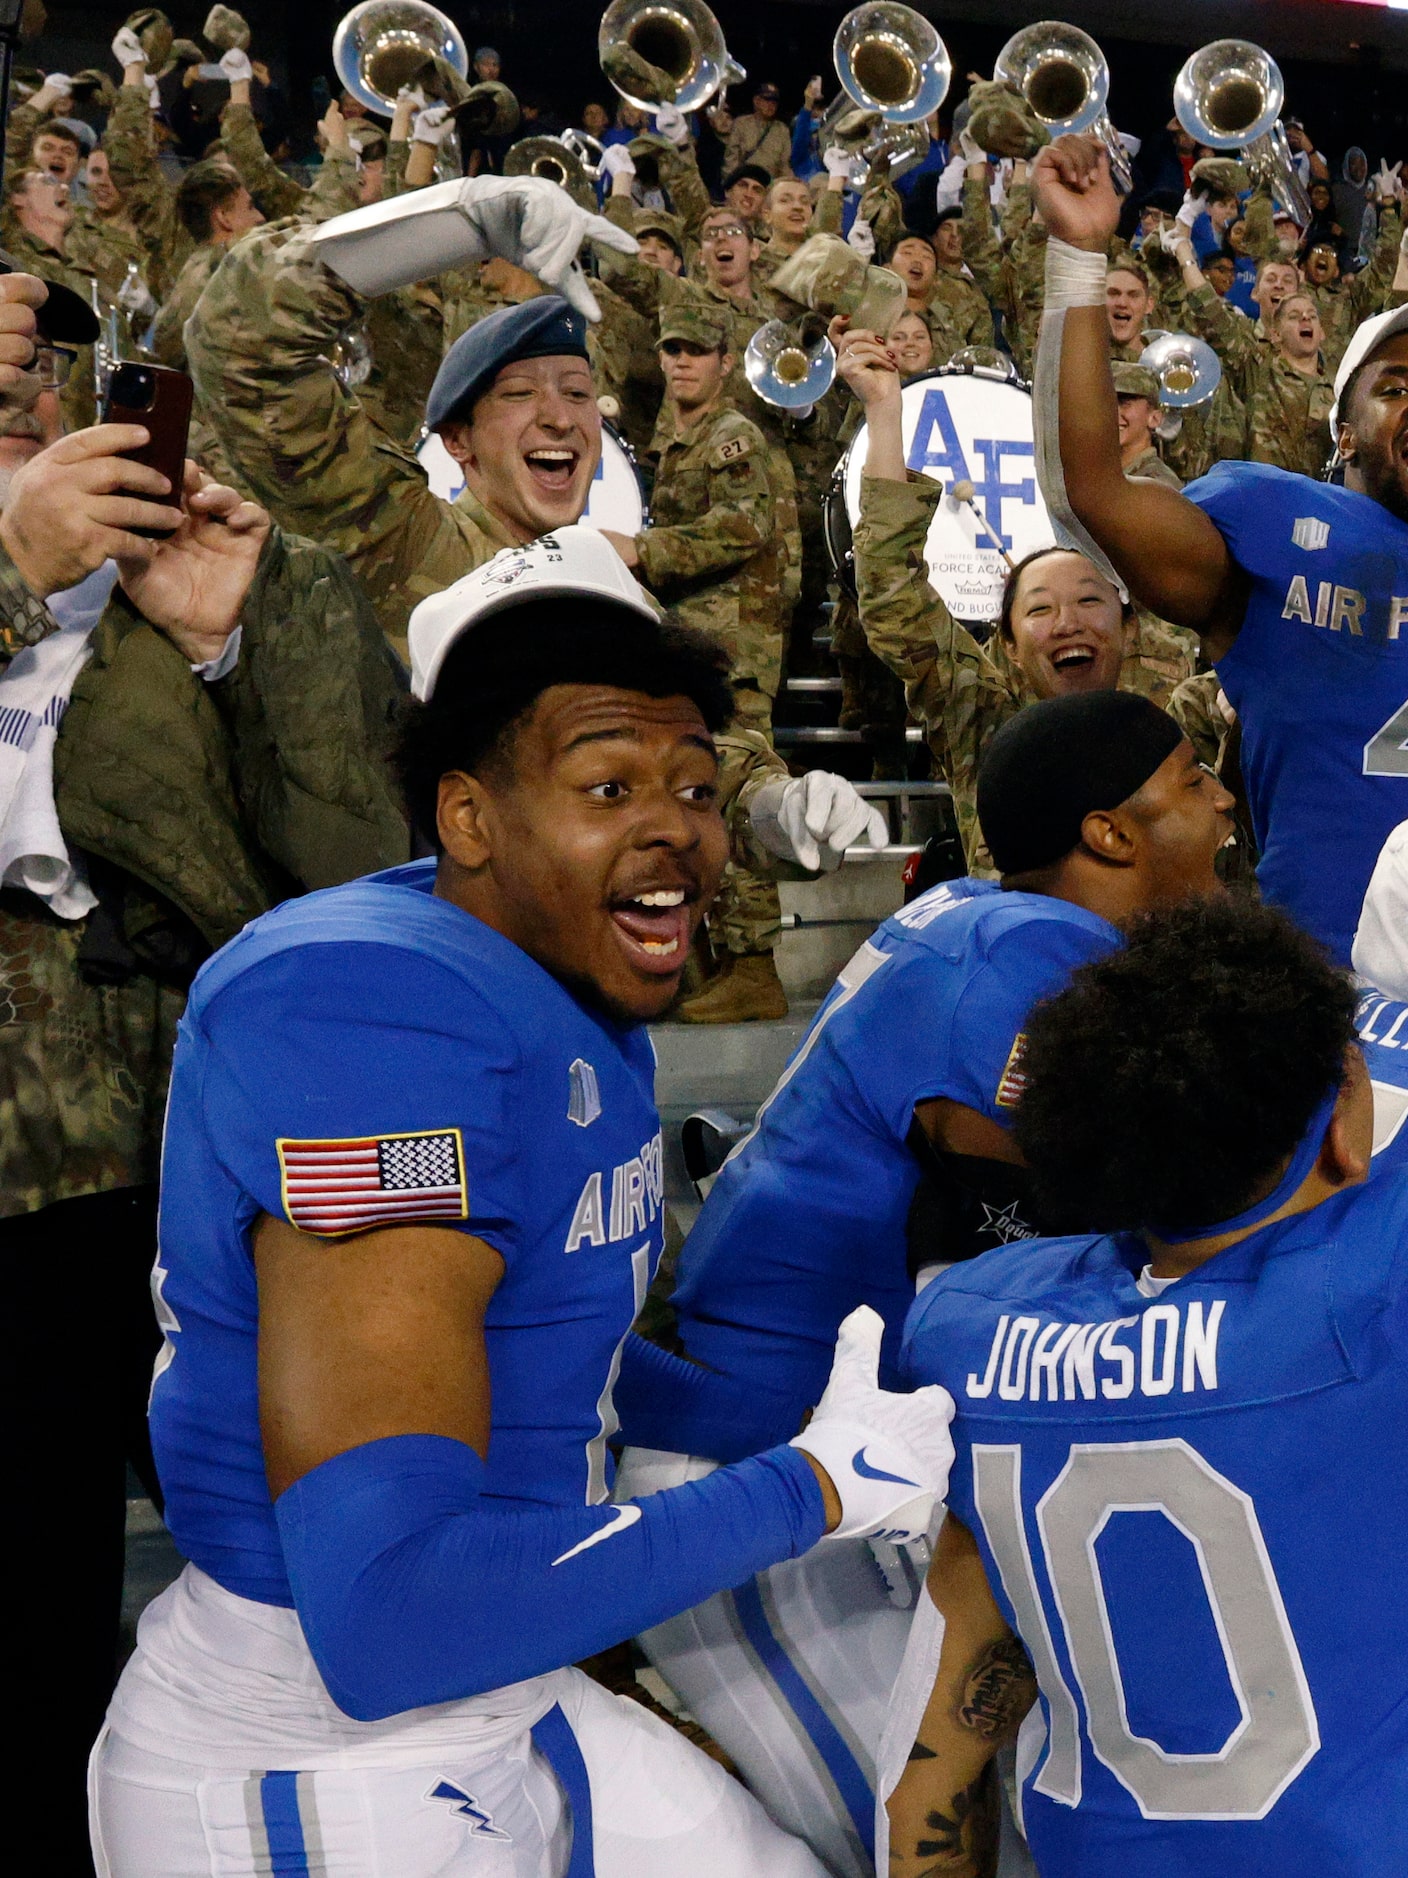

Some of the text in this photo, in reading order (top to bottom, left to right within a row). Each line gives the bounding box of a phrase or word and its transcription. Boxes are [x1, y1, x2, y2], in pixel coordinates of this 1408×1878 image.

[721, 440, 743, 459] 27
[547, 554, 563, 562] 23
[932, 562, 974, 574] FORCE
[1281, 575, 1366, 636] AIR
[564, 1157, 648, 1253] AIR
[966, 1300, 1226, 1402] JOHNSON
[971, 1437, 1321, 1820] 10
